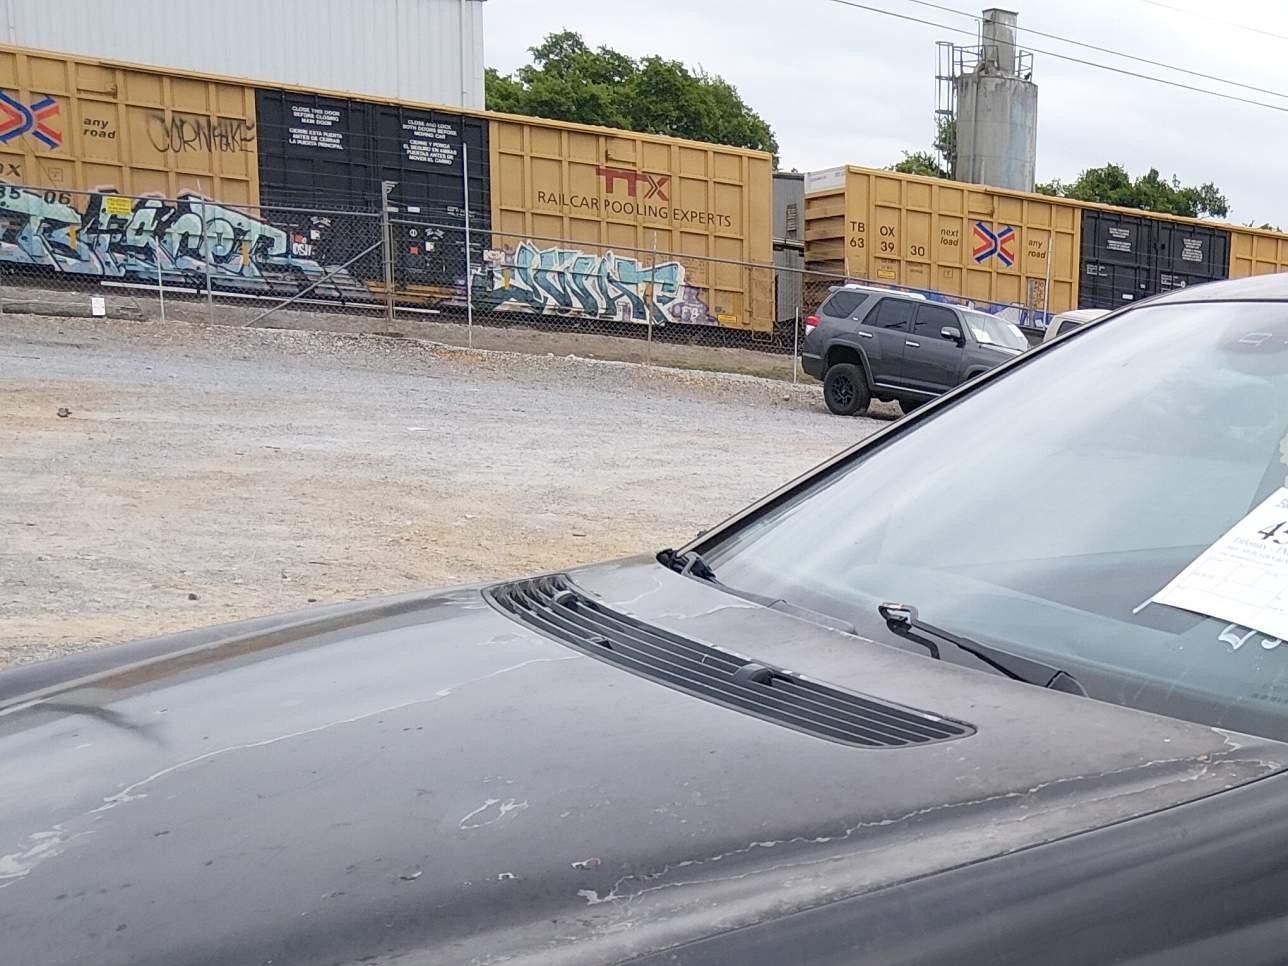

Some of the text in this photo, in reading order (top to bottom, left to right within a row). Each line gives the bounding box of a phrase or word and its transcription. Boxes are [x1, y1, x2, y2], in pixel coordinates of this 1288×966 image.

[83, 116, 109, 129] any
[83, 127, 117, 140] road
[595, 165, 670, 201] TTX
[43, 190, 72, 205] 06
[537, 190, 731, 228] RAILCAR POOLING EXPERTS
[850, 220, 896, 238] TB OX
[940, 228, 959, 238] next
[849, 237, 925, 257] 63 39 30
[940, 237, 960, 247] load
[1028, 239, 1043, 249] any
[1027, 249, 1047, 259] road
